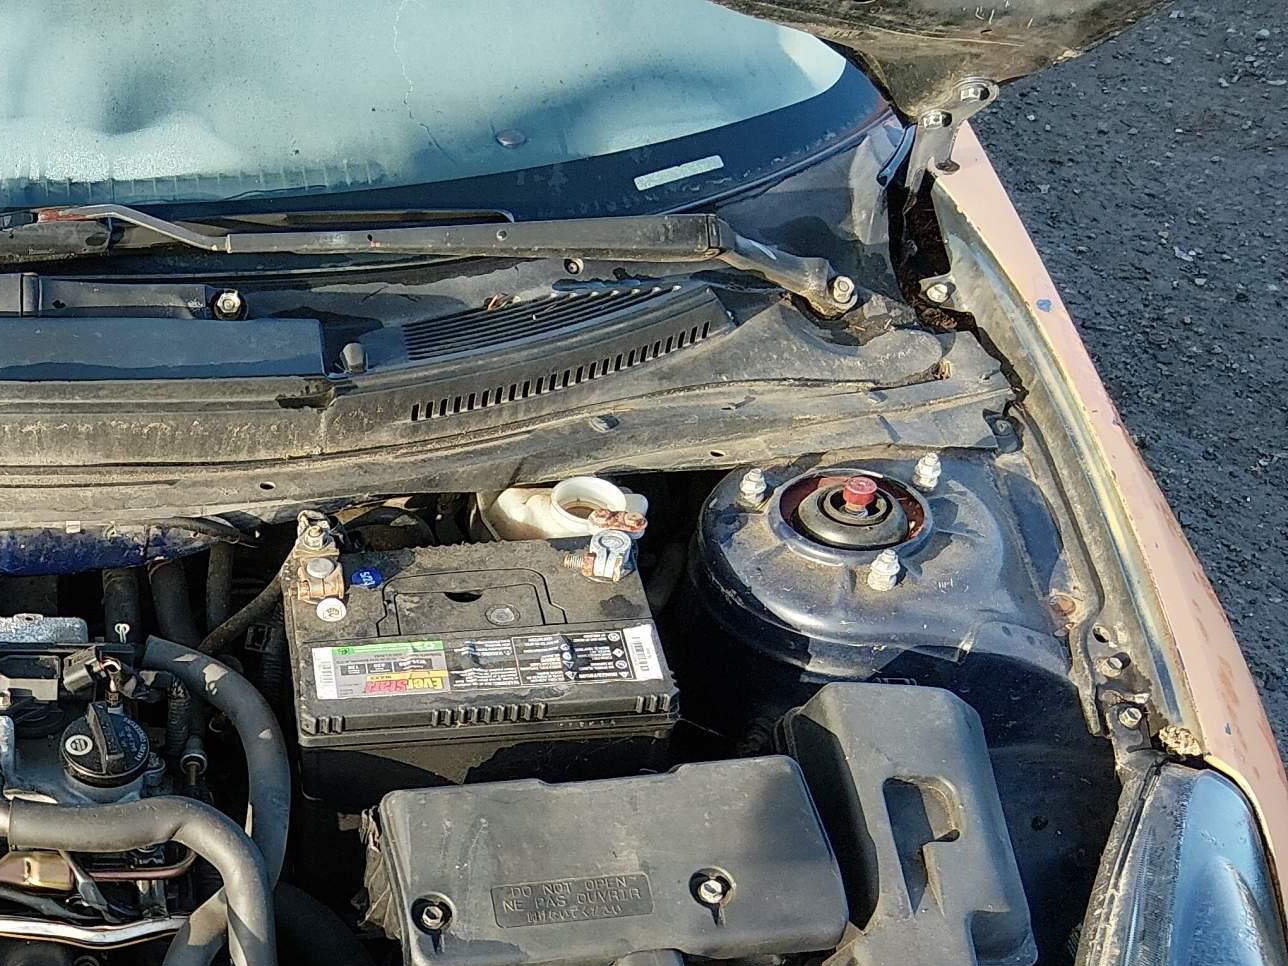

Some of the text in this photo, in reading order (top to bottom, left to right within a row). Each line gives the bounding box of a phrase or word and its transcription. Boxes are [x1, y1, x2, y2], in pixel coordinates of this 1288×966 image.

[510, 877, 627, 898] DO NOT OPEN
[502, 888, 641, 913] NE PAS OUVRIR
